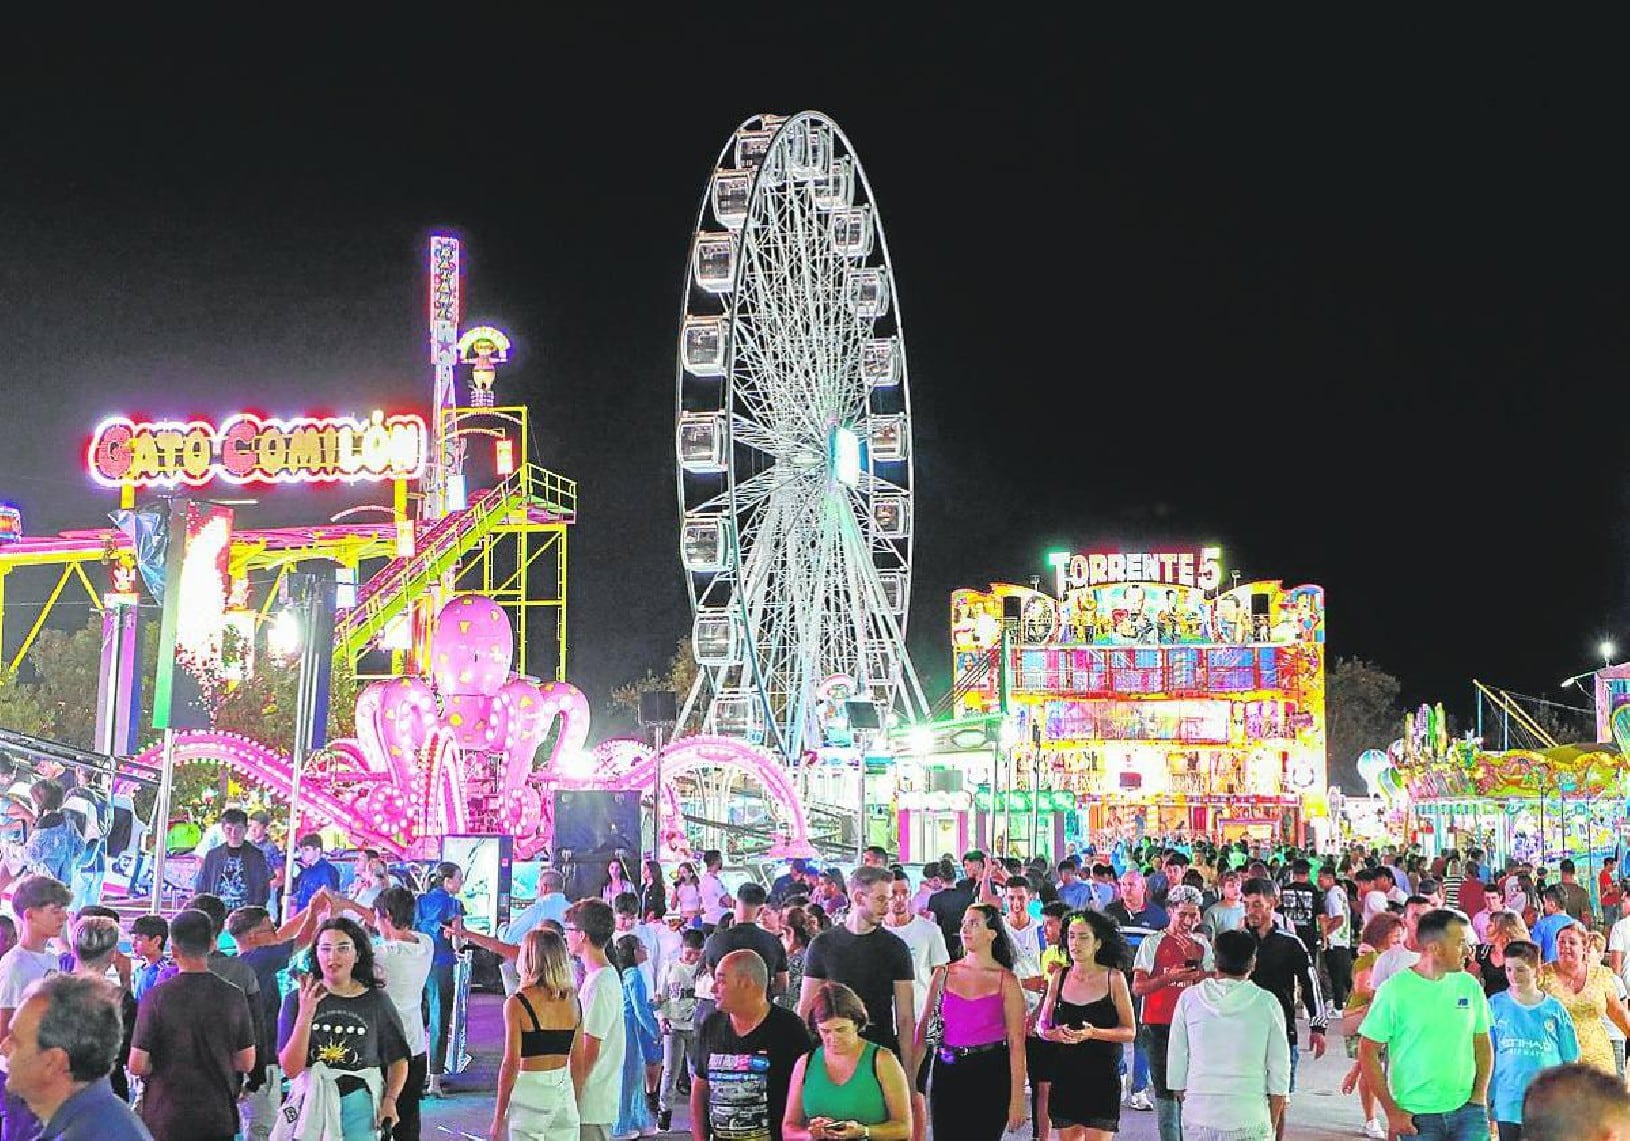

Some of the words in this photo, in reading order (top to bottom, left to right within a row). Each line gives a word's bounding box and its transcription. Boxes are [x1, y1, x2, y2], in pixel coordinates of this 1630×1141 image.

[99, 426, 210, 478] GATO
[1048, 552, 1194, 597] TORRENTE
[1199, 547, 1220, 590] 5
